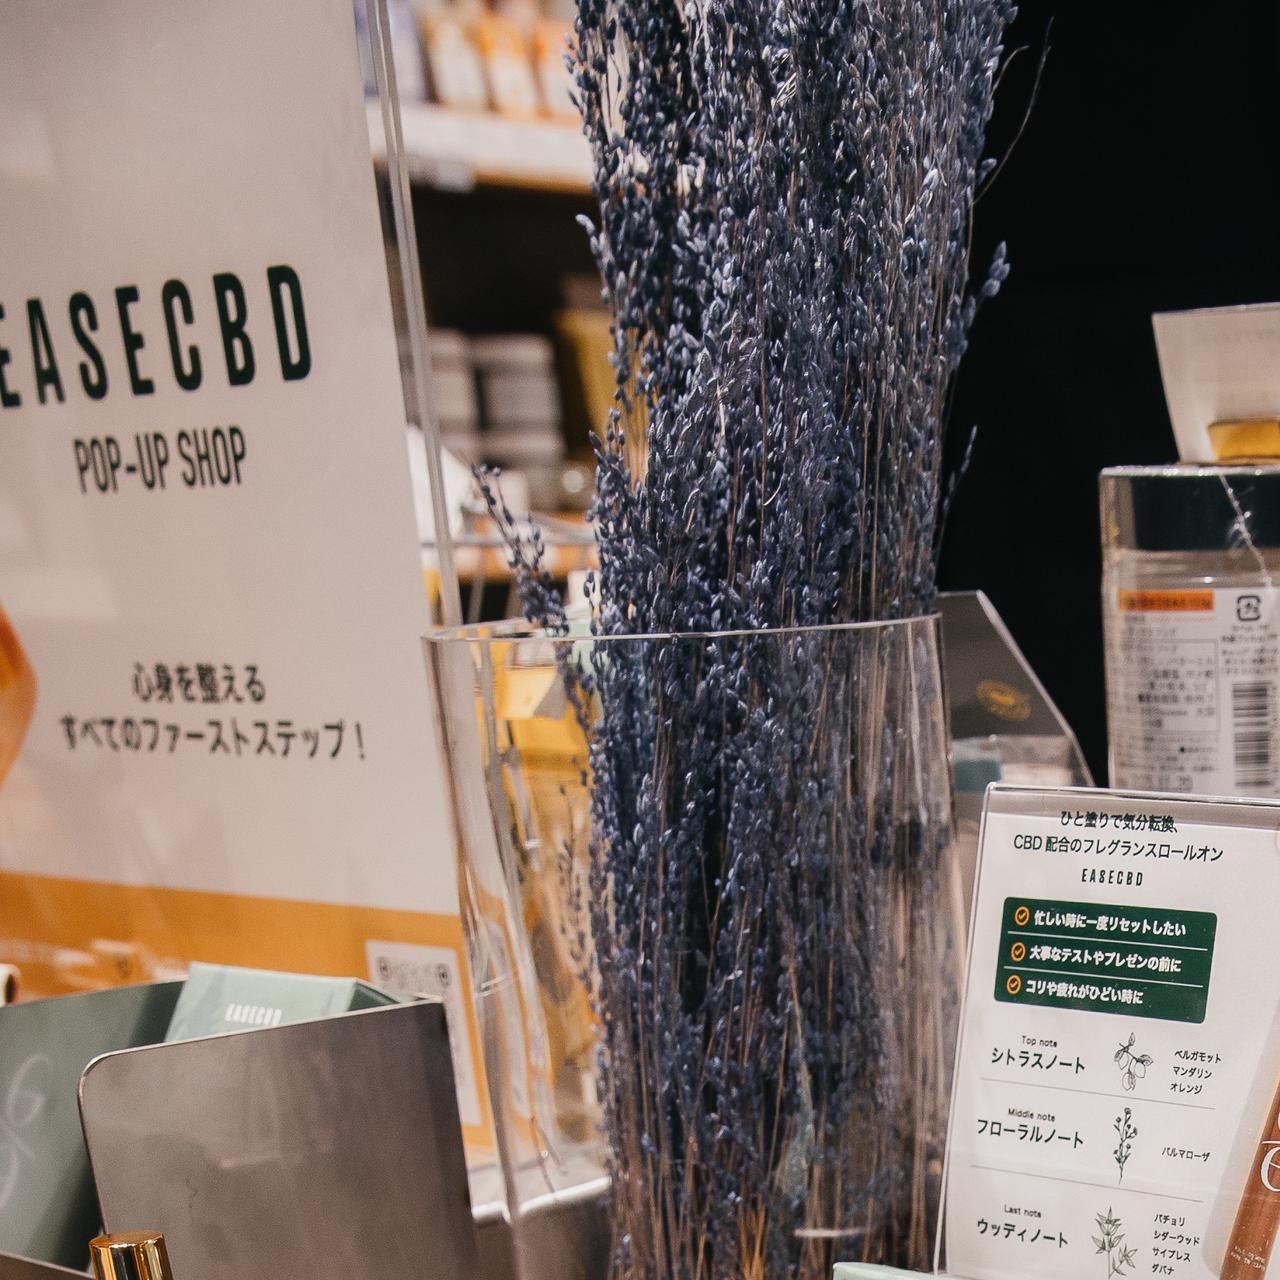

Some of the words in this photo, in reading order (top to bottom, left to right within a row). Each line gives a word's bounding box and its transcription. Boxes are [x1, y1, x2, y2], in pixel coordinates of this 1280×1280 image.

[73, 431, 169, 494] POP-UP
[177, 424, 247, 488] SHOP
[132, 661, 267, 703] 心身を整える
[1081, 868, 1143, 886] EASECBD
[1034, 909, 1187, 936] 忙しい時に一度リセットしたい
[1029, 944, 1182, 972] 大事なテストやプレゼンの前に
[1025, 979, 1143, 1005] コリや疲れがひどい時に
[1021, 1035, 1037, 1048] Top
[1039, 1039, 1058, 1048] note
[991, 1047, 1086, 1074] シトラスノート
[1174, 1049, 1223, 1064] ベルガモット
[1172, 1065, 1213, 1080] マンダリン
[1170, 1082, 1203, 1095] オレンジ
[1008, 1107, 1035, 1120] Middle
[1036, 1111, 1056, 1123] note
[977, 1118, 1084, 1149] フローラルノート
[1003, 1203, 1022, 1216] Last
[1023, 1207, 1042, 1219] note
[976, 1217, 1069, 1249] ウッディノート
[1153, 1230, 1201, 1246] シダーウッド
